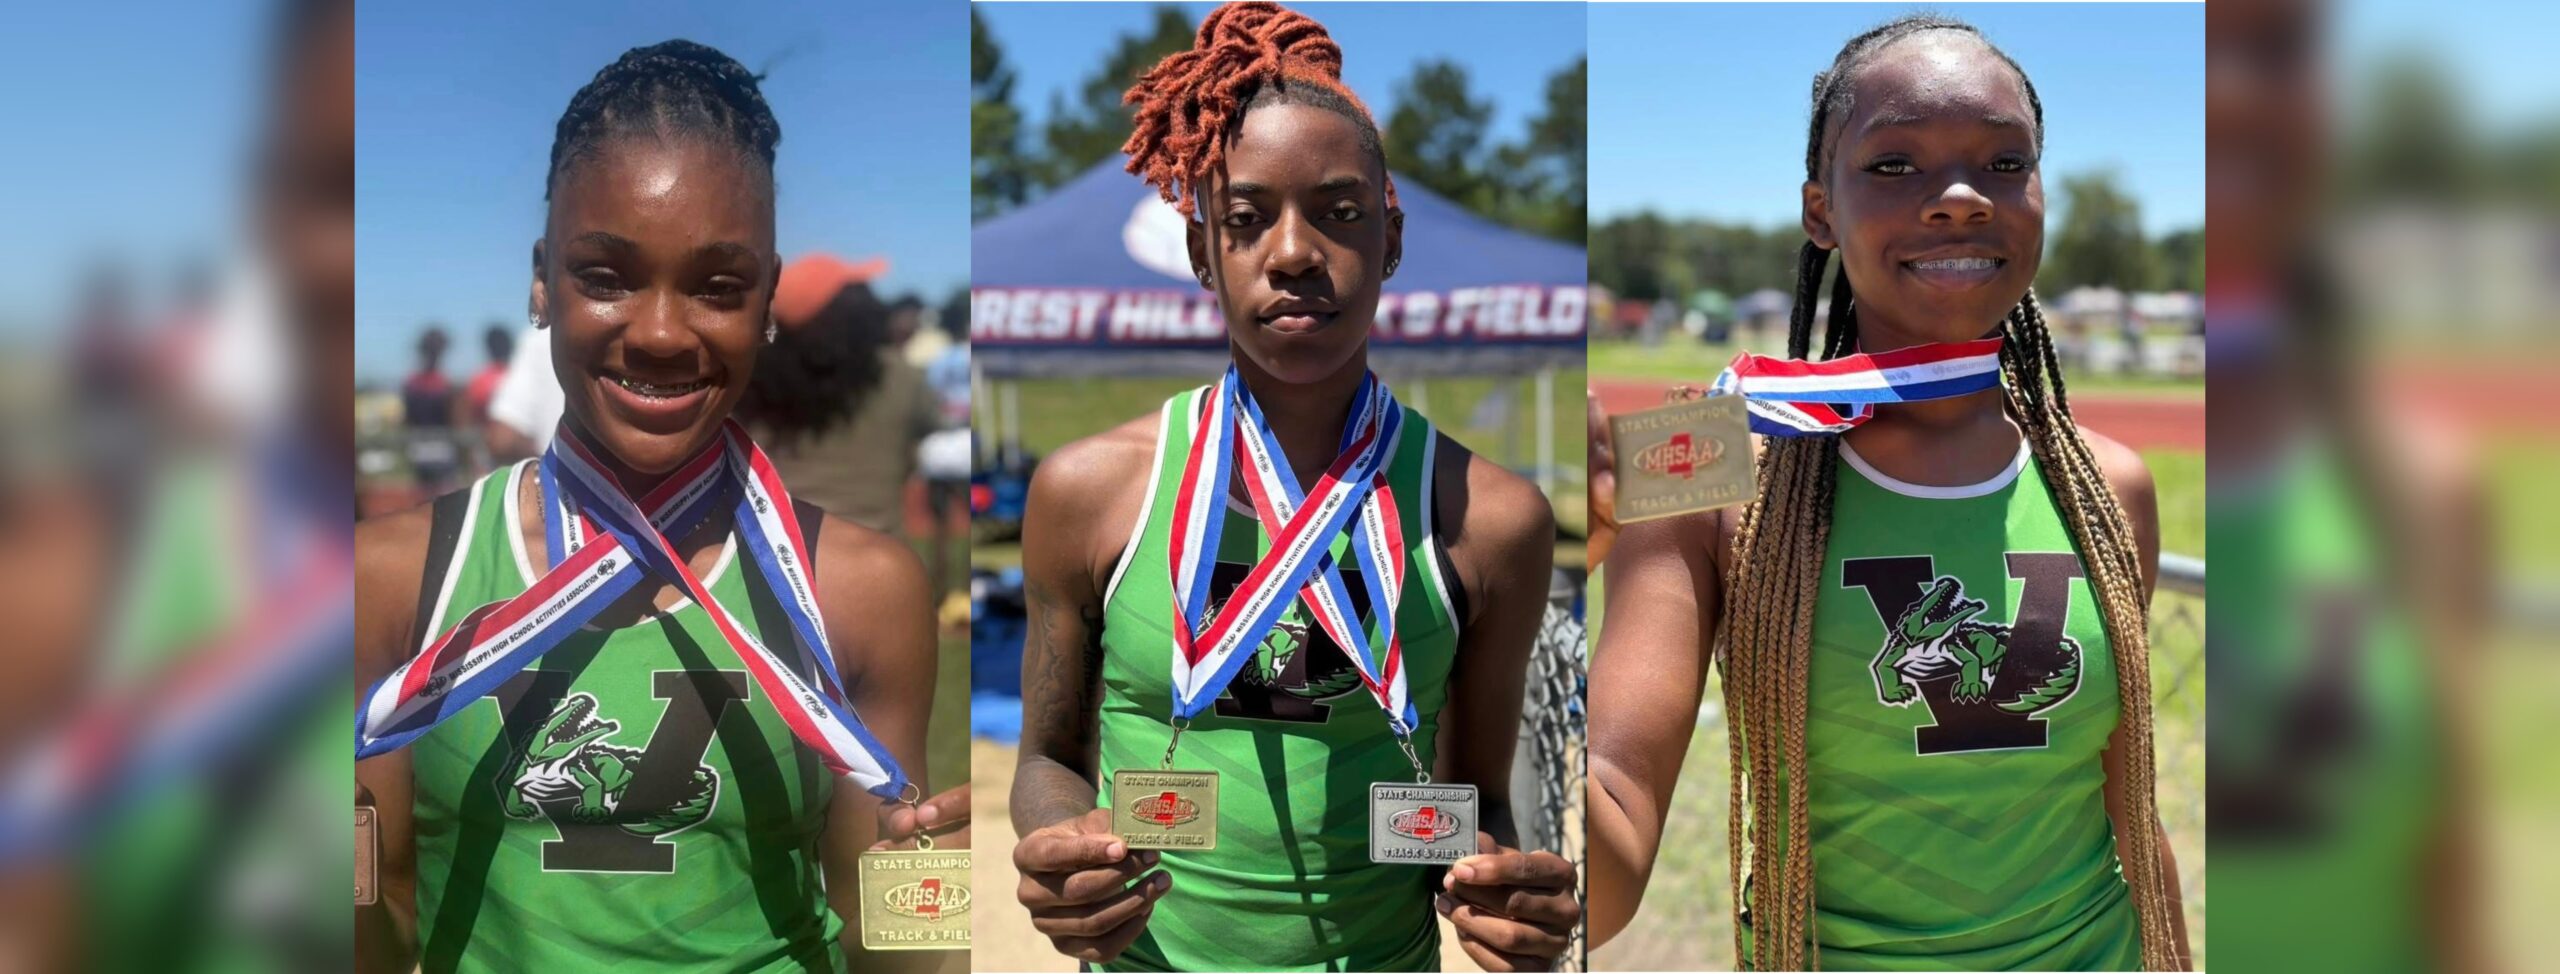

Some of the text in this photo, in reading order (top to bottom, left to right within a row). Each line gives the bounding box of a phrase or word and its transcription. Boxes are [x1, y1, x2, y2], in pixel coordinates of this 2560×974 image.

[1445, 285, 1587, 336] FIELD
[1618, 405, 1730, 434] STATE CHAMPION
[1644, 440, 1713, 472] MHSAA
[1631, 494, 1678, 512] TRACK
[1699, 484, 1739, 500] FIELD
[1236, 511, 1328, 634] MISSISSIPPI HIGH SCHOOL ACTIVITIES ASSOCIATION
[1379, 552, 1389, 575] SCHOOL
[1318, 585, 1332, 606] SCHOOL
[449, 573, 599, 681] MISSISSIPPI HIGH SCHOOL ACTIVITIES ASSOCIATION
[1123, 775, 1209, 788] STATE CHAMPION
[1377, 790, 1473, 802] STATE CHAMPIONSHIP
[1139, 799, 1192, 816] MHSAA
[1395, 814, 1452, 831] MHSAA
[1124, 833, 1160, 845] TRACK
[1174, 834, 1205, 846] FIELD
[1384, 847, 1465, 859] TRACK & FIELD
[873, 858, 971, 870] STATE CHAMPIO
[895, 886, 961, 907] MHSAA
[880, 930, 924, 941] TRACK
[928, 930, 938, 941] &
